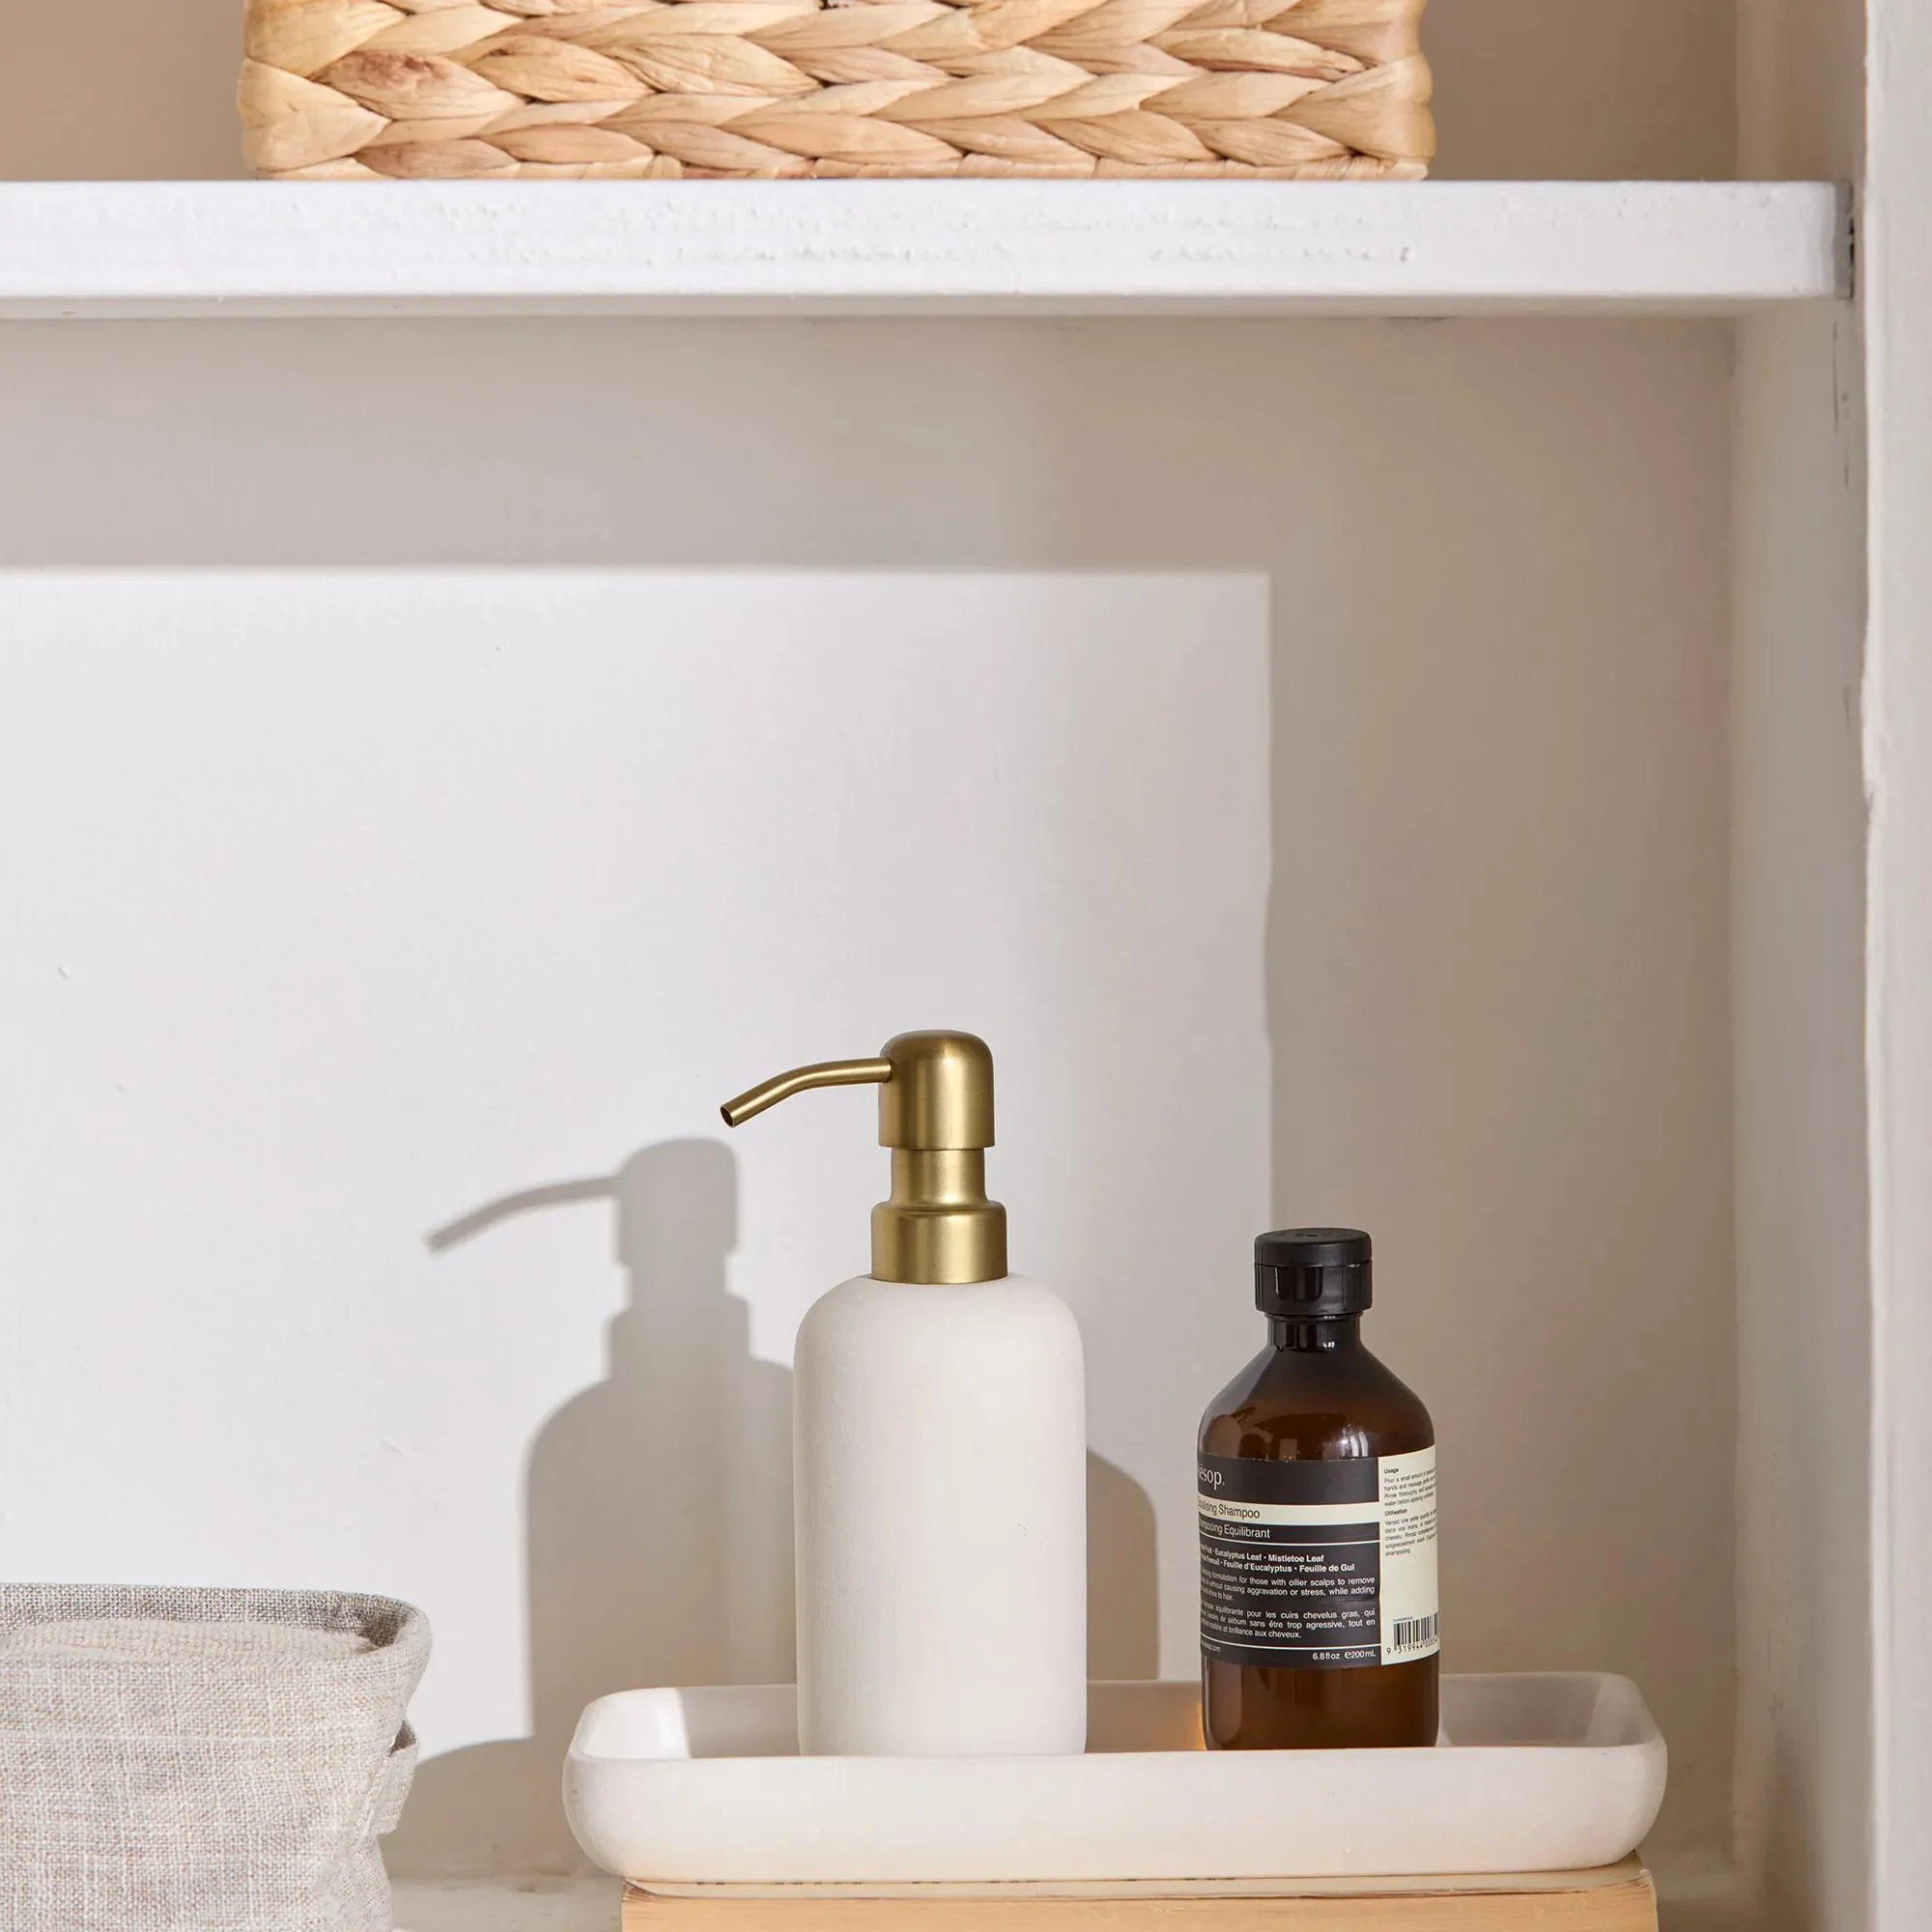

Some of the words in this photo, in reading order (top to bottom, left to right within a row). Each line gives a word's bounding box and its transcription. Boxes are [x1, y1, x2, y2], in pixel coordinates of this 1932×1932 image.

[1218, 1504, 1260, 1520] Shampoo
[1224, 1524, 1270, 1539] Equilibrant
[1215, 1548, 1245, 1560] Eucalyptus
[1246, 1552, 1262, 1561] Leaf
[1224, 1560, 1243, 1569] Feuille
[1244, 1563, 1293, 1573] d'Eucalyptus
[1341, 1563, 1355, 1572] Gui
[1249, 1577, 1268, 1585] those
[1310, 1578, 1335, 1587] scalps
[1223, 1584, 1245, 1594] causing
[1246, 1587, 1288, 1596] aggravation
[1300, 1588, 1326, 1597] stress,
[1350, 1586, 1376, 1595] adding
[1265, 1610, 1277, 1619] les
[1341, 1610, 1360, 1620] gras,
[1364, 1608, 1376, 1618] qui
[1228, 1626, 1254, 1635] brillance
[1254, 1629, 1267, 1637] aux
[1267, 1630, 1302, 1638] cheveux.
[1306, 1621, 1346, 1631] agressive,
[1385, 1646, 1392, 1655] 9
